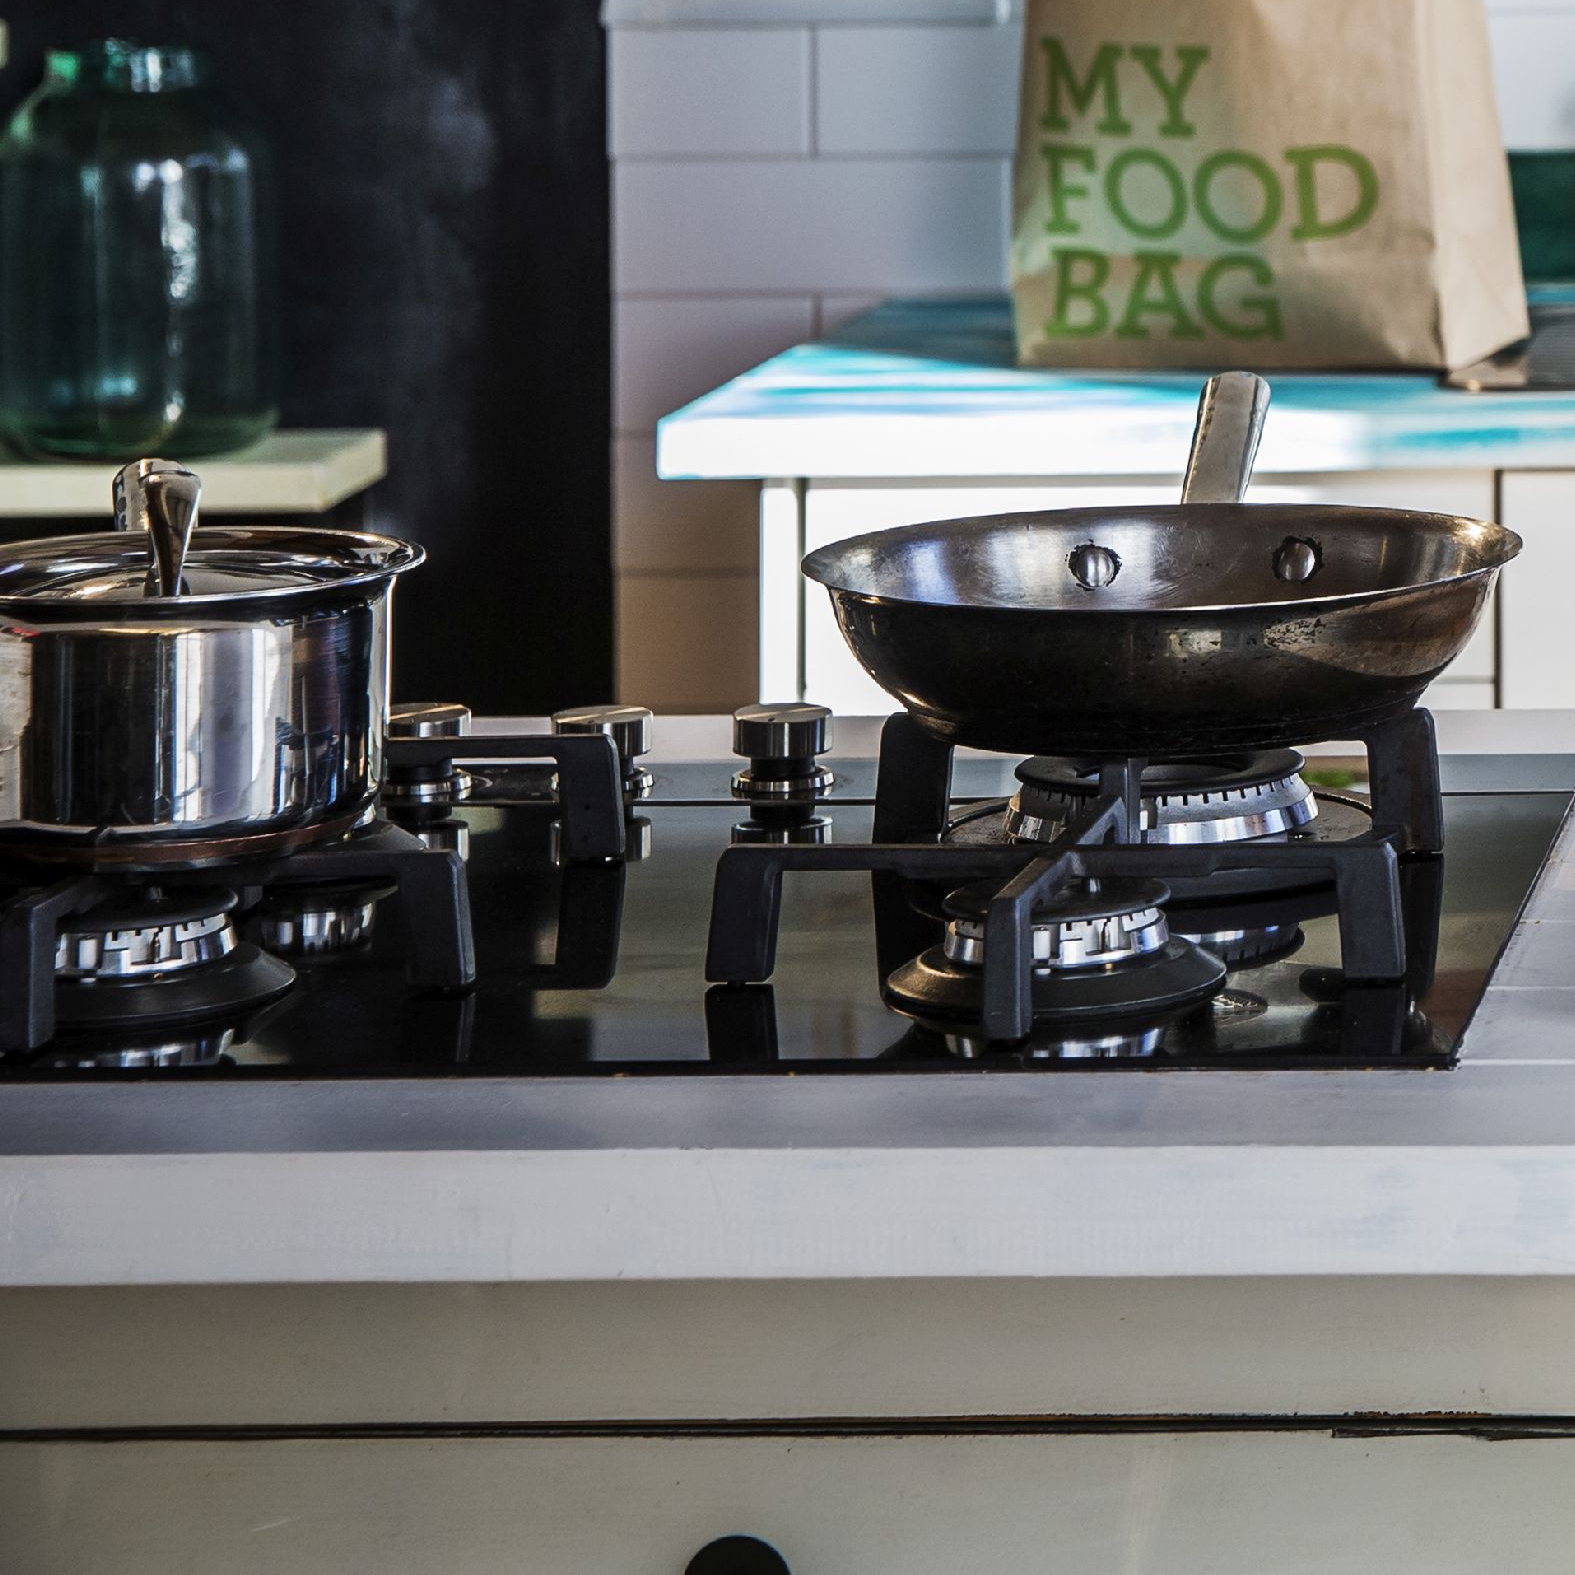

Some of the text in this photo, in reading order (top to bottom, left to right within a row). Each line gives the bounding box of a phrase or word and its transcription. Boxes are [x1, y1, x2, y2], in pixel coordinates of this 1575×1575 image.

[1039, 36, 1211, 138] MY
[1040, 143, 1380, 245] FOOD
[1045, 246, 1285, 341] BAG
